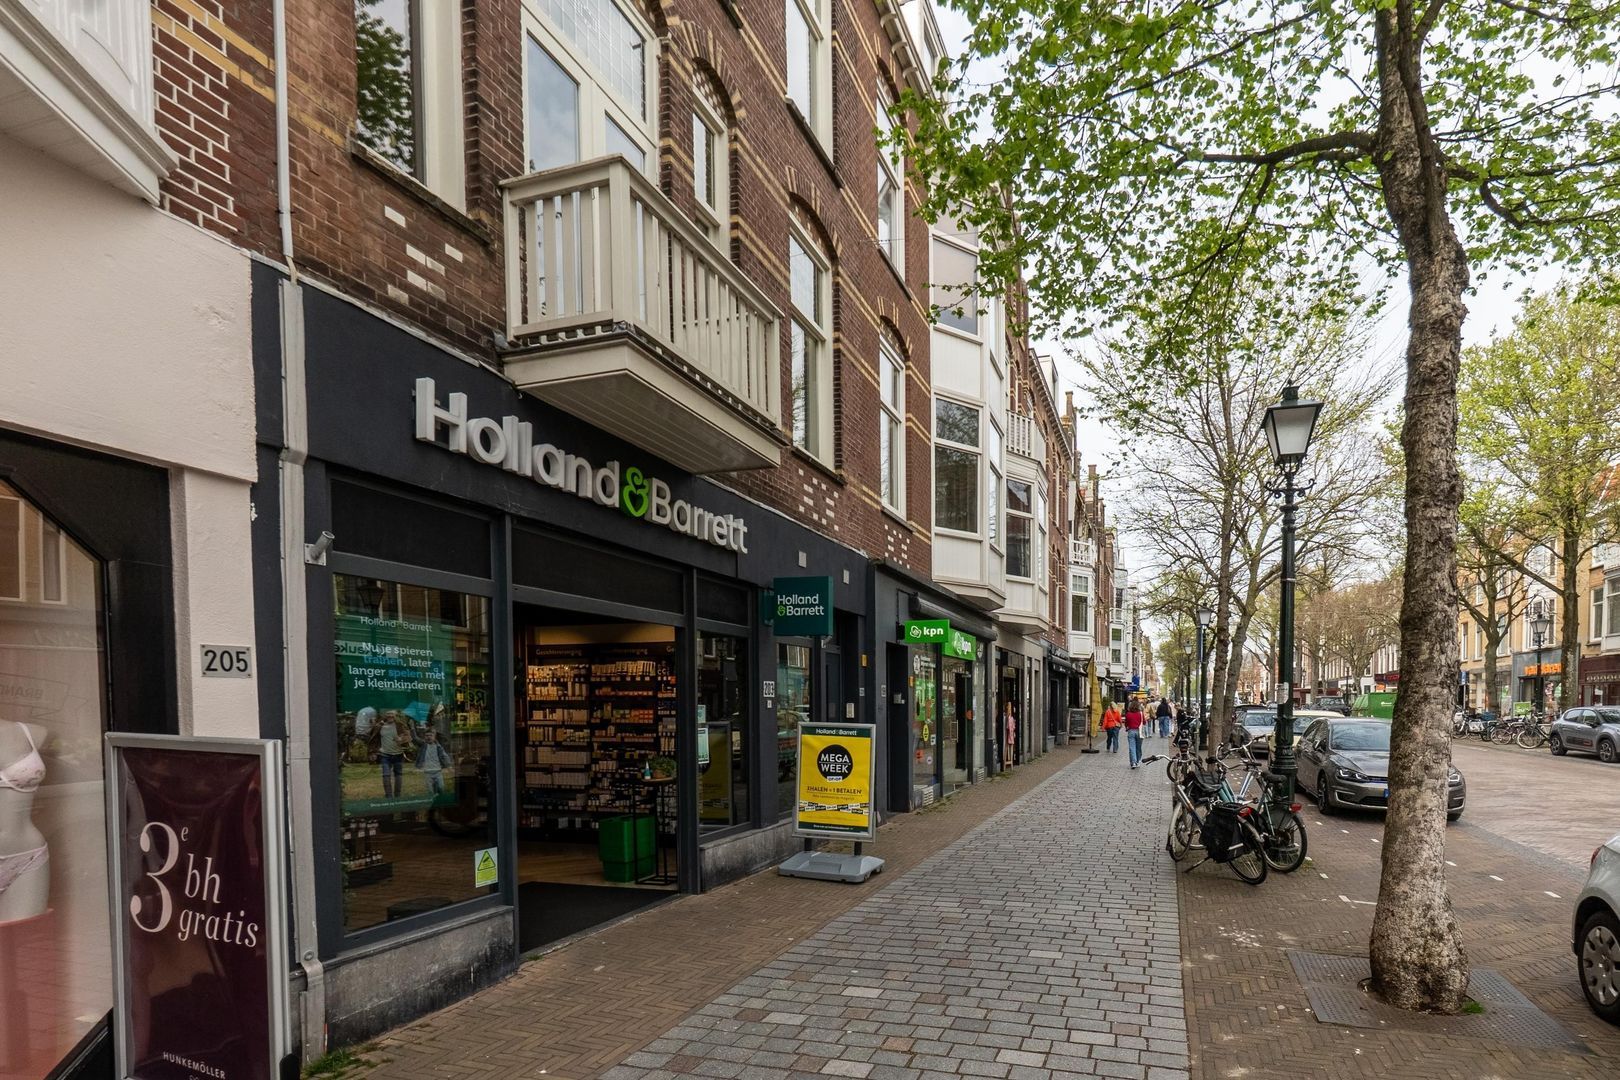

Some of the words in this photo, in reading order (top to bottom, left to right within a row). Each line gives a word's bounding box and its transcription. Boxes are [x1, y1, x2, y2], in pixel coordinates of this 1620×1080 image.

[415, 377, 620, 508] Holland
[647, 477, 748, 554] Barrett
[777, 594, 819, 605] Holland
[786, 605, 825, 616] Barrett
[360, 616, 396, 628] Holland
[403, 621, 433, 632] Barrett
[923, 626, 944, 637] kpn
[362, 642, 378, 652] Nu
[394, 645, 433, 657] spieren
[203, 650, 249, 672] 205
[408, 657, 432, 667] later
[347, 664, 386, 678] langer
[388, 668, 423, 678] spelen
[425, 670, 445, 679] met
[354, 677, 365, 689] je
[367, 678, 441, 690] kleinkinderen
[820, 754, 850, 763] MEGA
[821, 764, 849, 773] WEEK
[184, 853, 221, 903] bh
[178, 910, 259, 948] gratis
